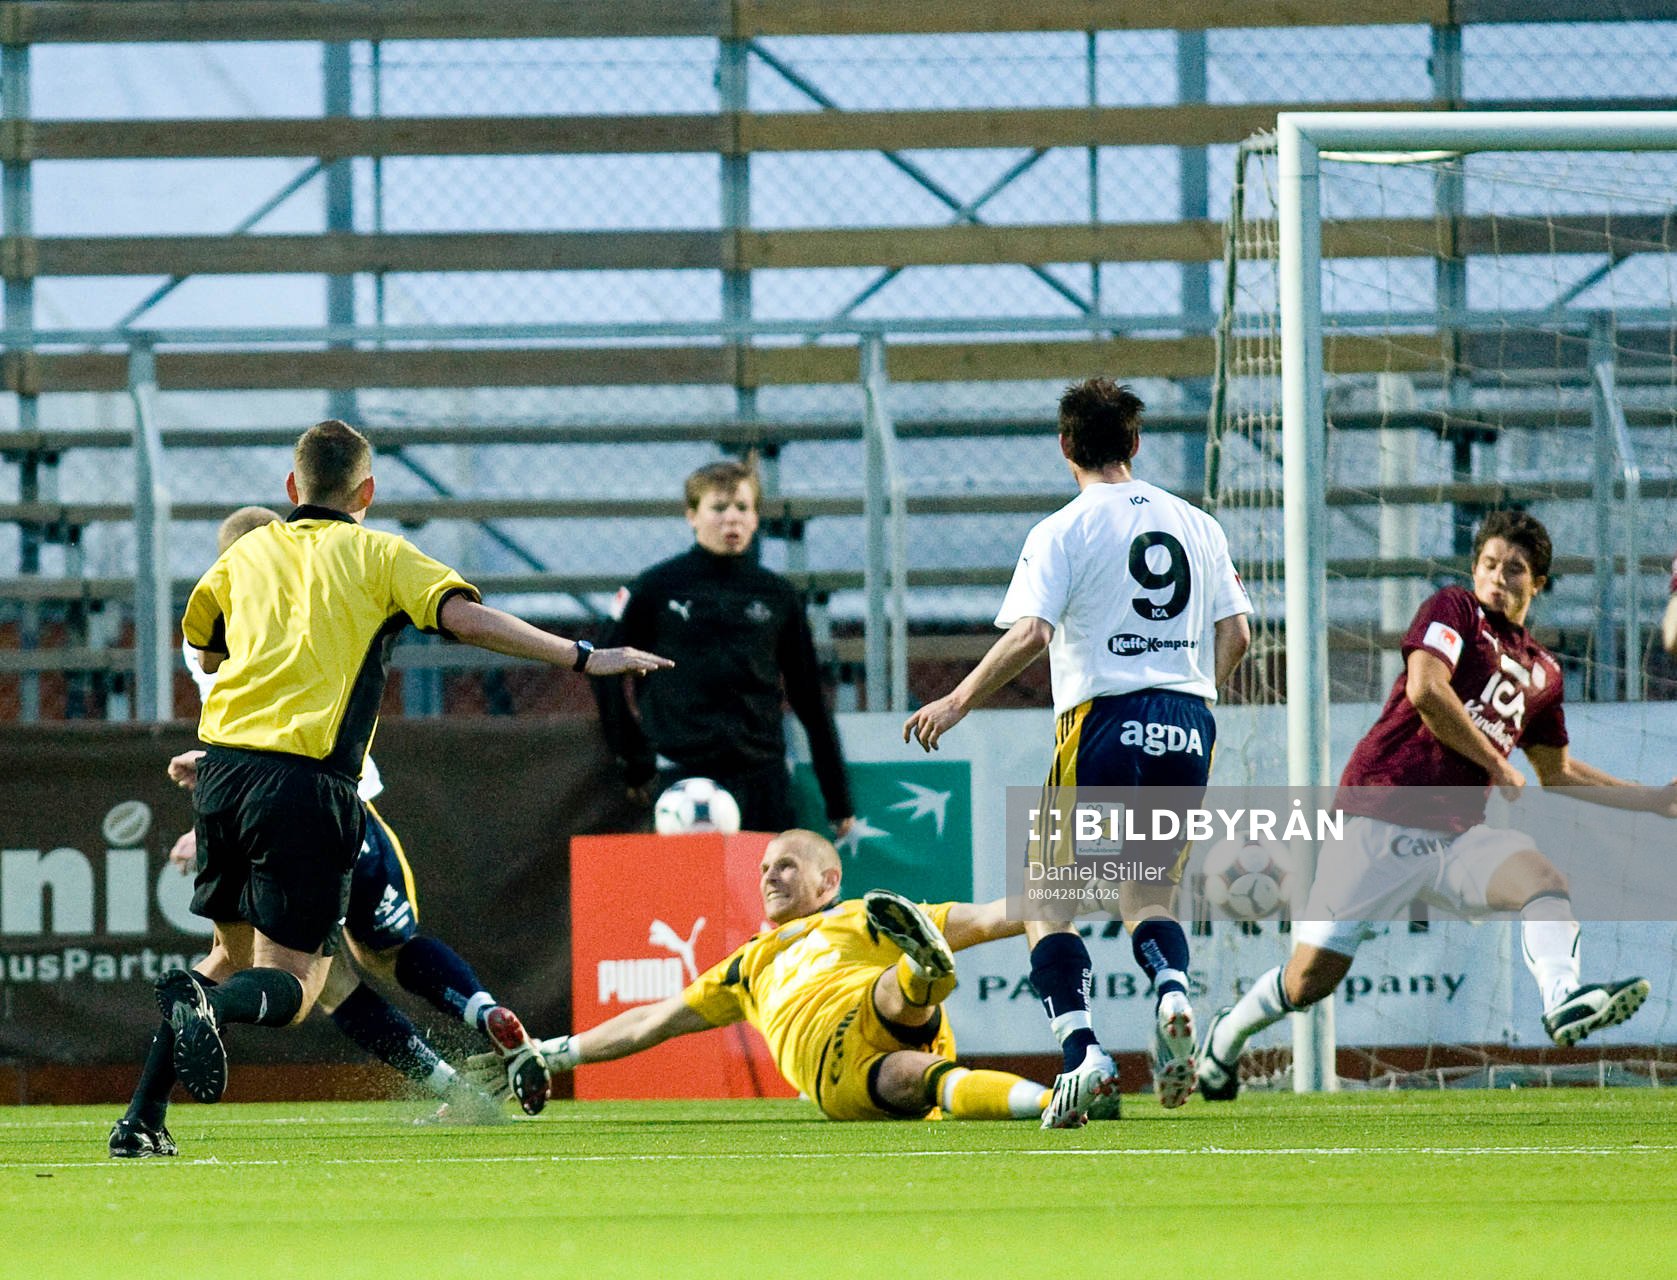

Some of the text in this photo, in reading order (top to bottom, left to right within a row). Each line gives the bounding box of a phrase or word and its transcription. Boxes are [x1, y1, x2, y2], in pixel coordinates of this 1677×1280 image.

[1129, 496, 1150, 506] ICA
[1128, 531, 1191, 621] 9
[1151, 607, 1169, 619] ICA
[0, 949, 212, 981] usPartn
[597, 957, 683, 1004] PUMA
